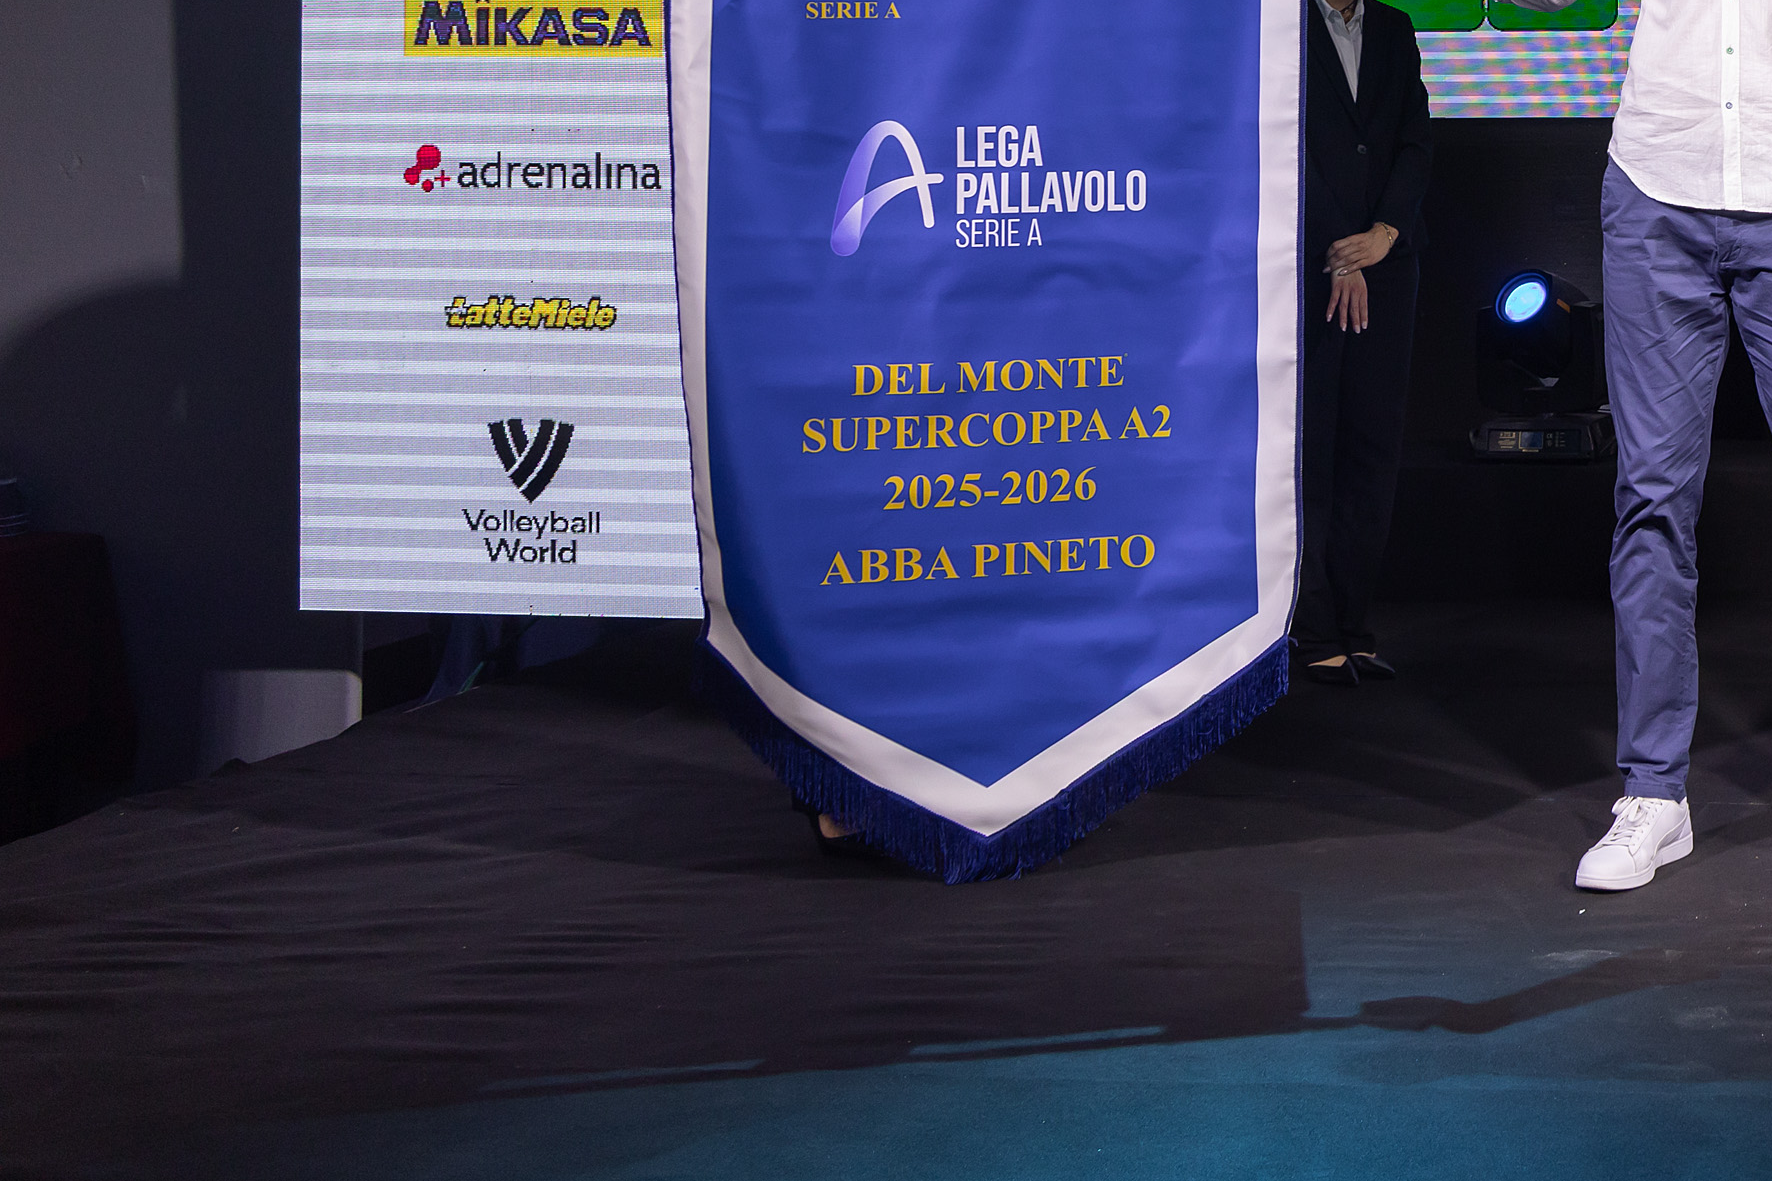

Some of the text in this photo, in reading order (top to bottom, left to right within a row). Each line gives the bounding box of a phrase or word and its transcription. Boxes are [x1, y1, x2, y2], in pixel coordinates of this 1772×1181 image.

[805, 1, 901, 20] SERIE A
[956, 125, 1043, 168] LEGA
[457, 151, 662, 191] adrenalina
[956, 169, 1147, 215] PALLAVOLO
[956, 218, 1043, 248] SERIE A
[851, 355, 1126, 396] DEL MONTE
[802, 404, 1172, 454] SUPERCOPPA A2
[883, 466, 1097, 511] 2025-2026
[462, 508, 600, 540] Volleyball
[484, 536, 577, 563] World
[819, 534, 1156, 586] ABBA PINETO
